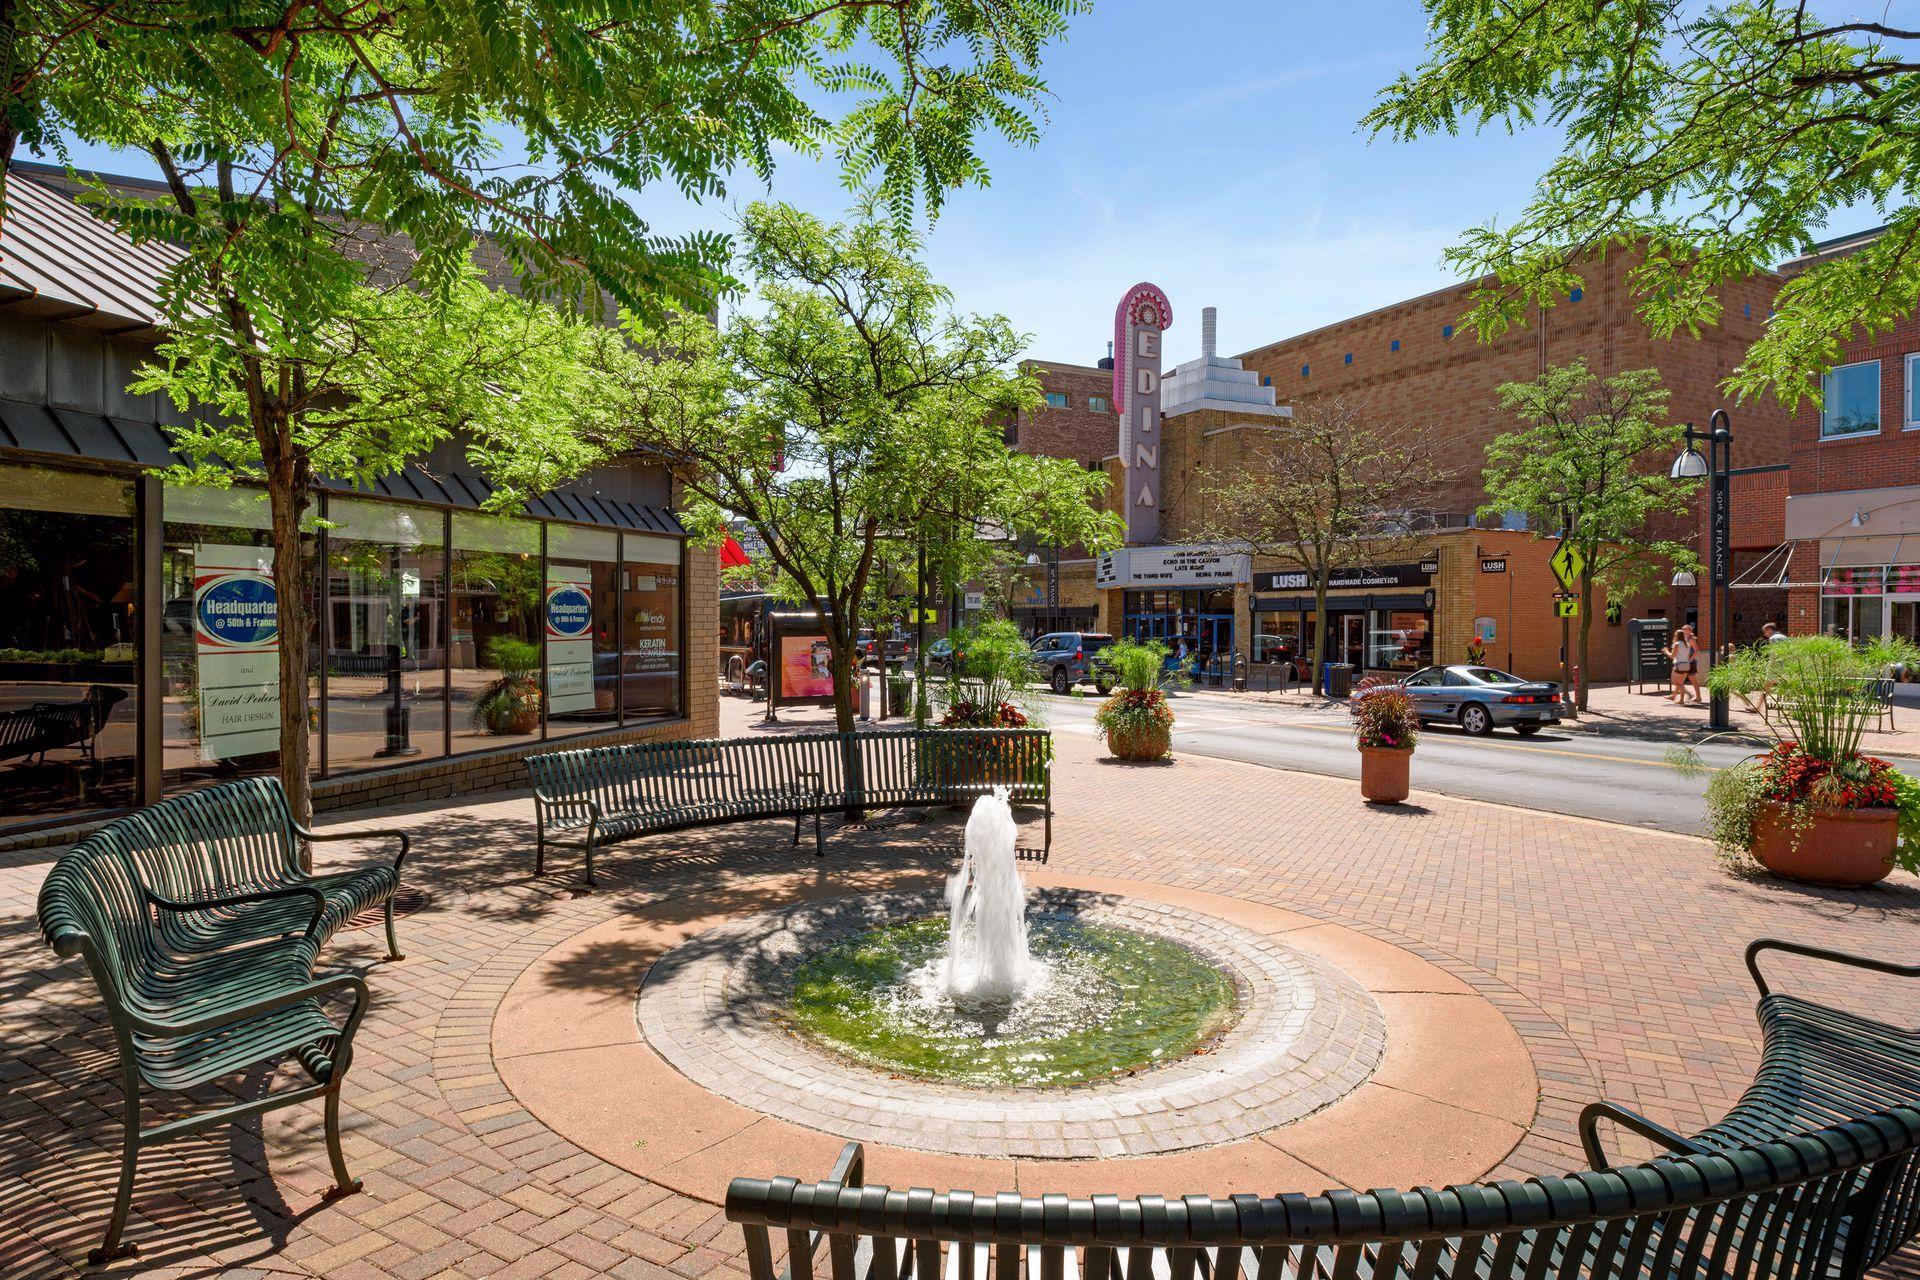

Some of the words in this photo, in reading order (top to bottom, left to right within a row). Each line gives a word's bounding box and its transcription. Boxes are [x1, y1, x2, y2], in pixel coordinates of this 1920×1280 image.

[1135, 330, 1159, 507] EDINA
[1716, 513, 1723, 527] &
[1421, 563, 1437, 571] LUSH
[1482, 561, 1504, 570] LUSH
[1272, 574, 1306, 589] LUSH
[1328, 578, 1361, 587] HANDMADE
[1362, 576, 1398, 585] COSMETICS
[935, 575, 944, 605] ANCE
[206, 599, 277, 616] Headquarter
[551, 603, 588, 614] Headquarters
[215, 618, 226, 629] @
[227, 617, 244, 628] 50th
[245, 617, 252, 627] &
[253, 617, 277, 627] France
[640, 638, 666, 648] KERATIN
[240, 664, 254, 674] and
[221, 713, 242, 724] HAIR
[244, 711, 274, 722] DESIGN
